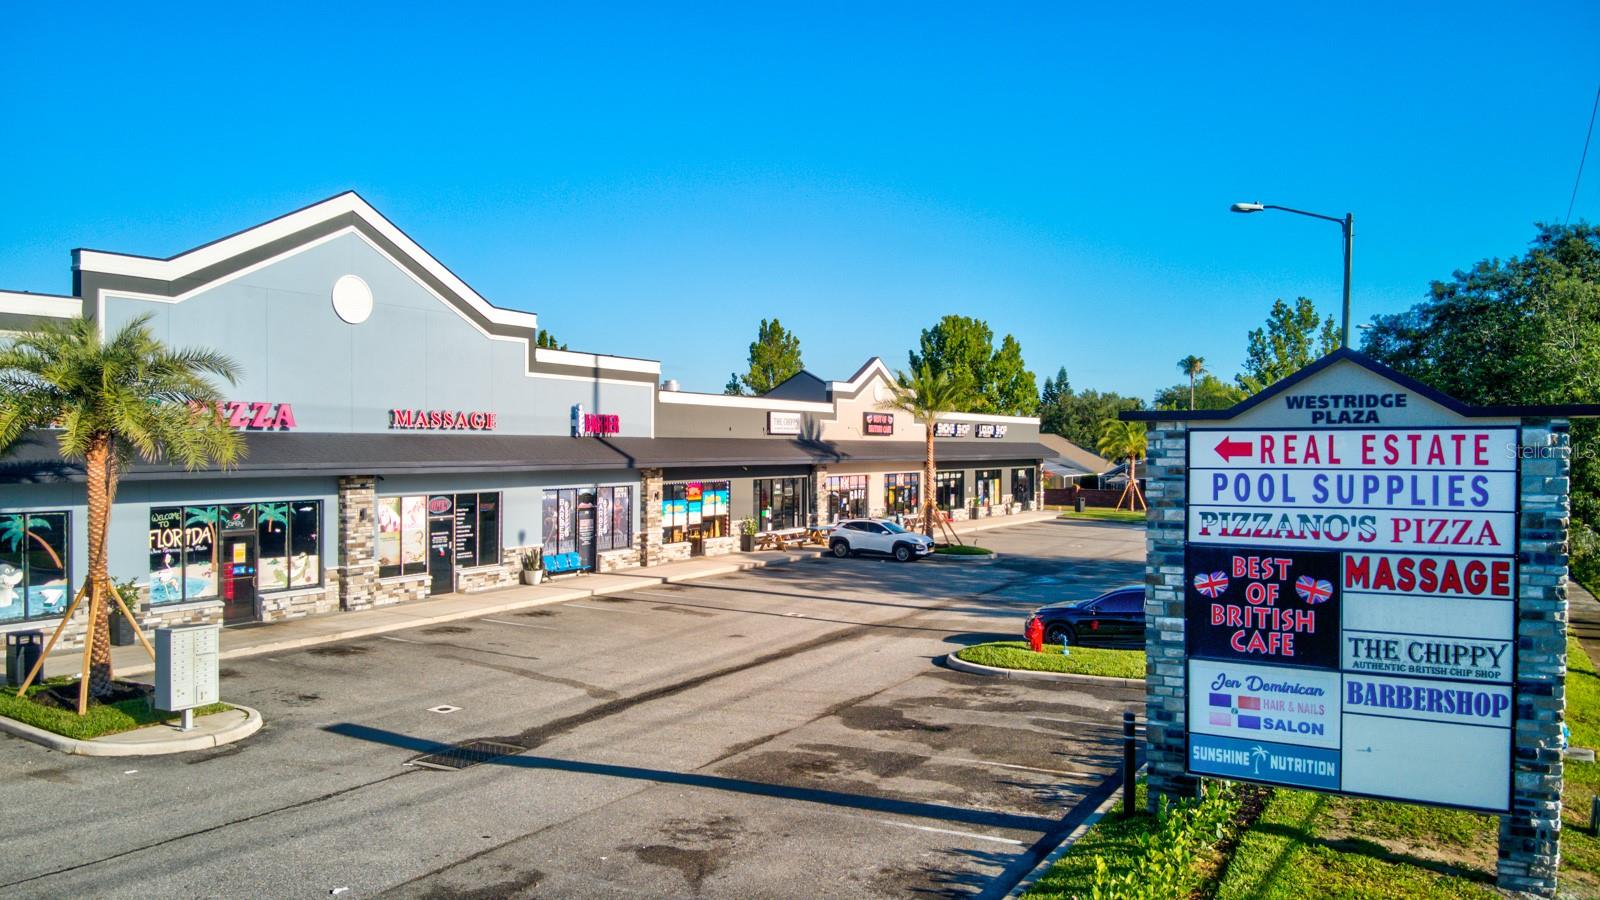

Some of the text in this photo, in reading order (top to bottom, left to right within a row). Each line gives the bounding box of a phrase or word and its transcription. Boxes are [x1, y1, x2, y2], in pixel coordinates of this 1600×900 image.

[1285, 393, 1408, 410] WESTRIDGE
[392, 409, 497, 431] MASSAGE
[1311, 410, 1380, 425] PLAZA
[1260, 434, 1490, 466] REAL ESTATE
[849, 489, 865, 500] CAFE
[1212, 472, 1490, 507] POOL SUPPLIES
[151, 512, 182, 522] WELCOME
[158, 520, 170, 528] TO
[1198, 511, 1501, 546] PIZZANO'S PIZZA
[1232, 555, 1293, 581] BEST
[1344, 555, 1510, 596] MASSAGE
[1245, 582, 1280, 606] OF
[1211, 603, 1316, 634] BRITISH
[1230, 630, 1295, 657] CAFE
[1348, 637, 1508, 669] THE CHIPPY
[1352, 661, 1501, 679] AUTHENTIC BRITISH CHIP SHOP
[1211, 673, 1325, 697] Jen Dominican
[1263, 699, 1325, 716] HAIR & NAILS
[1346, 680, 1509, 718] BARBERSHOP
[1263, 718, 1325, 736] SALON
[1193, 745, 1335, 777] SUNSHINE NUTRITION
